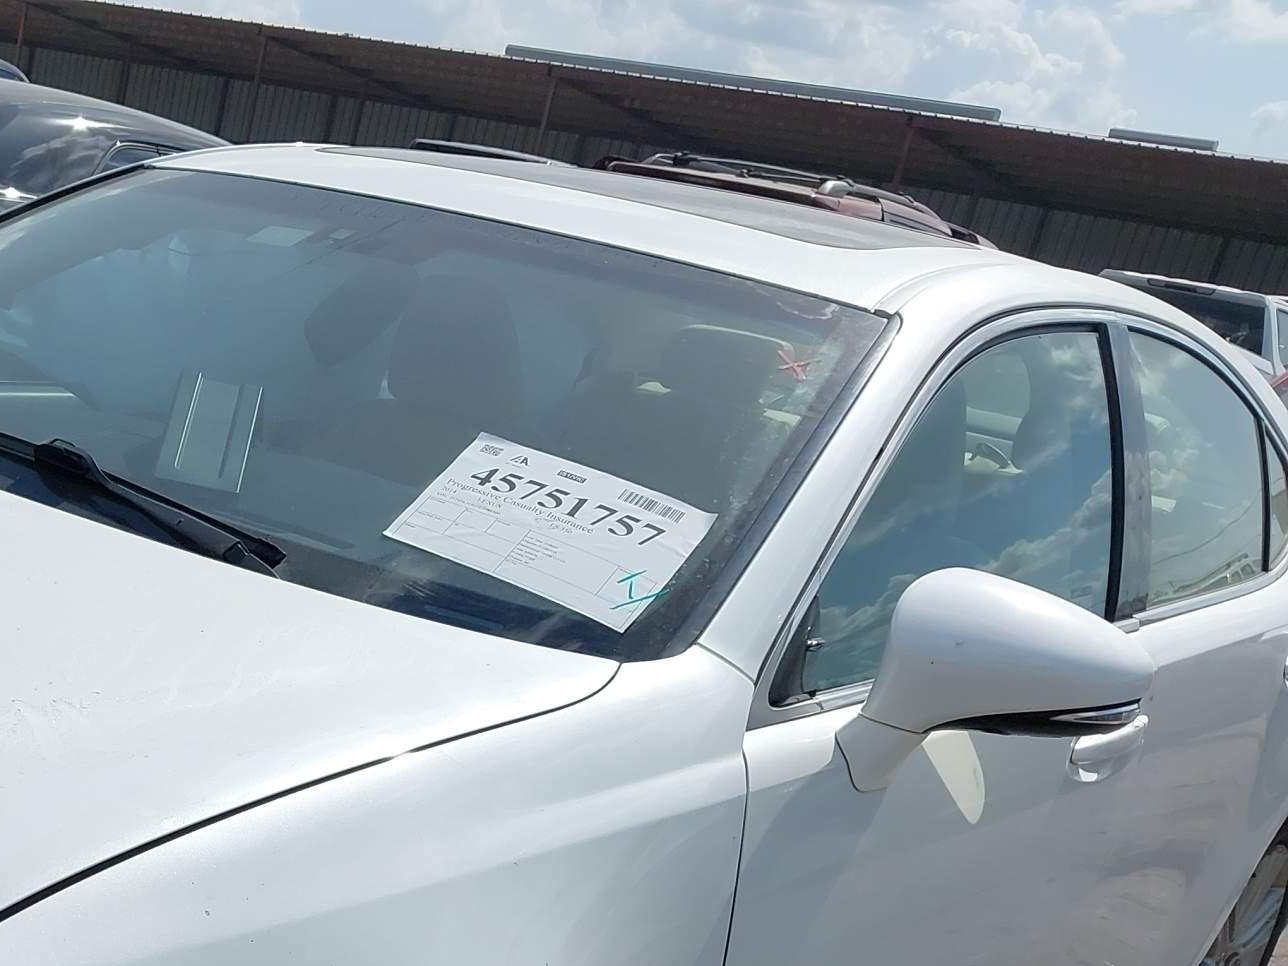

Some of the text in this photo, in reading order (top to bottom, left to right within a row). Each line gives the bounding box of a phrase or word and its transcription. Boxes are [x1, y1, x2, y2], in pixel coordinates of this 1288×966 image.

[447, 478, 502, 500] Progressive
[503, 496, 544, 516] Casualty
[546, 511, 593, 534] Insurance
[470, 468, 667, 546] 45751757
